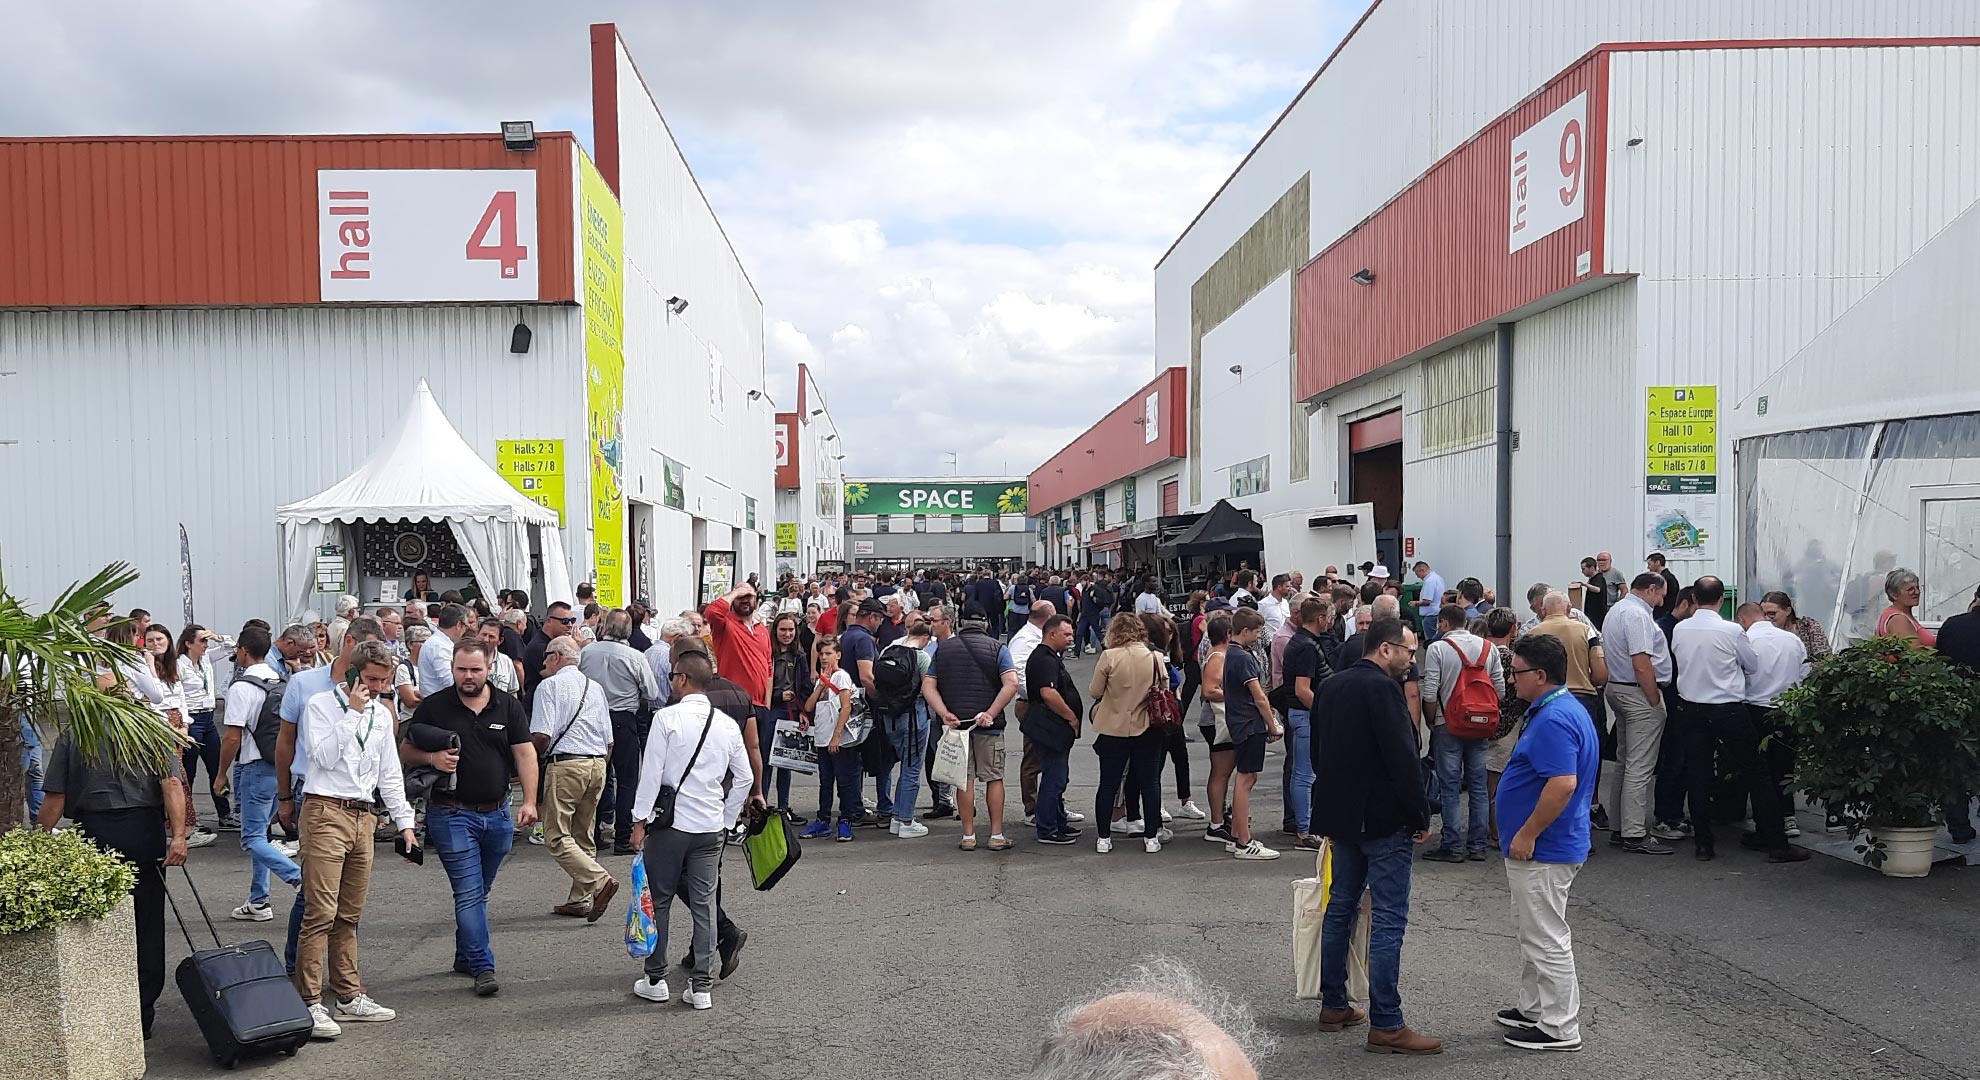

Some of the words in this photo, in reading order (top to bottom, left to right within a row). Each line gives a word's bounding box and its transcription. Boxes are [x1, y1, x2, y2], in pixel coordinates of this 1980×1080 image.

[1559, 119, 1582, 207] 9
[1512, 150, 1528, 233] hall
[328, 191, 371, 279] hall
[465, 191, 528, 279] 4
[1688, 390, 1695, 400] A
[1660, 407, 1687, 421] Espace
[1688, 407, 1713, 419] Europe
[1662, 425, 1679, 436] Hall
[1683, 425, 1693, 436] 10
[514, 443, 536, 454] Halls
[1657, 442, 1713, 456] Organisation
[513, 461, 535, 472] Halls
[1663, 460, 1685, 471] Halls
[536, 478, 543, 489] C
[542, 495, 549, 507] 5
[898, 489, 974, 509] SPACE
[1126, 485, 1135, 516] SPACE
